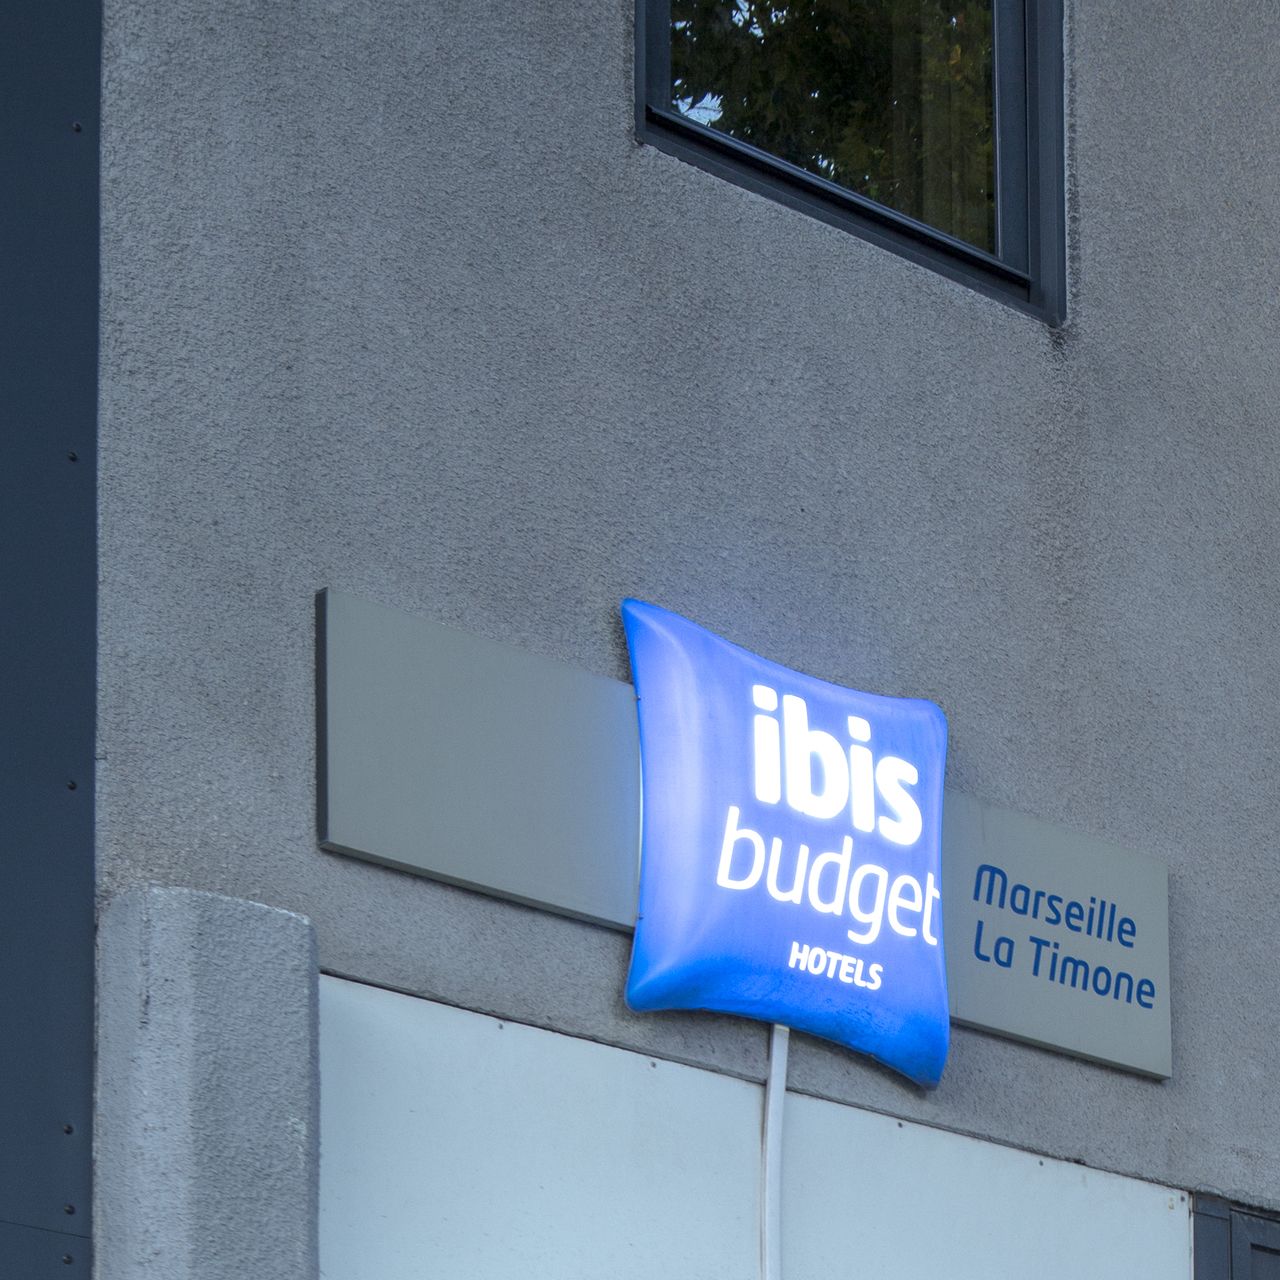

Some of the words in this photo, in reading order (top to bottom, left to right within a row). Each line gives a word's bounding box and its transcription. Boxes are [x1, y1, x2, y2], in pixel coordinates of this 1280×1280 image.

[752, 683, 923, 846] ibis
[716, 805, 939, 945] budget
[973, 862, 1137, 949] Marseille
[787, 940, 884, 991] HOTELS
[973, 920, 1014, 969] La
[1029, 934, 1157, 1010] Timone
